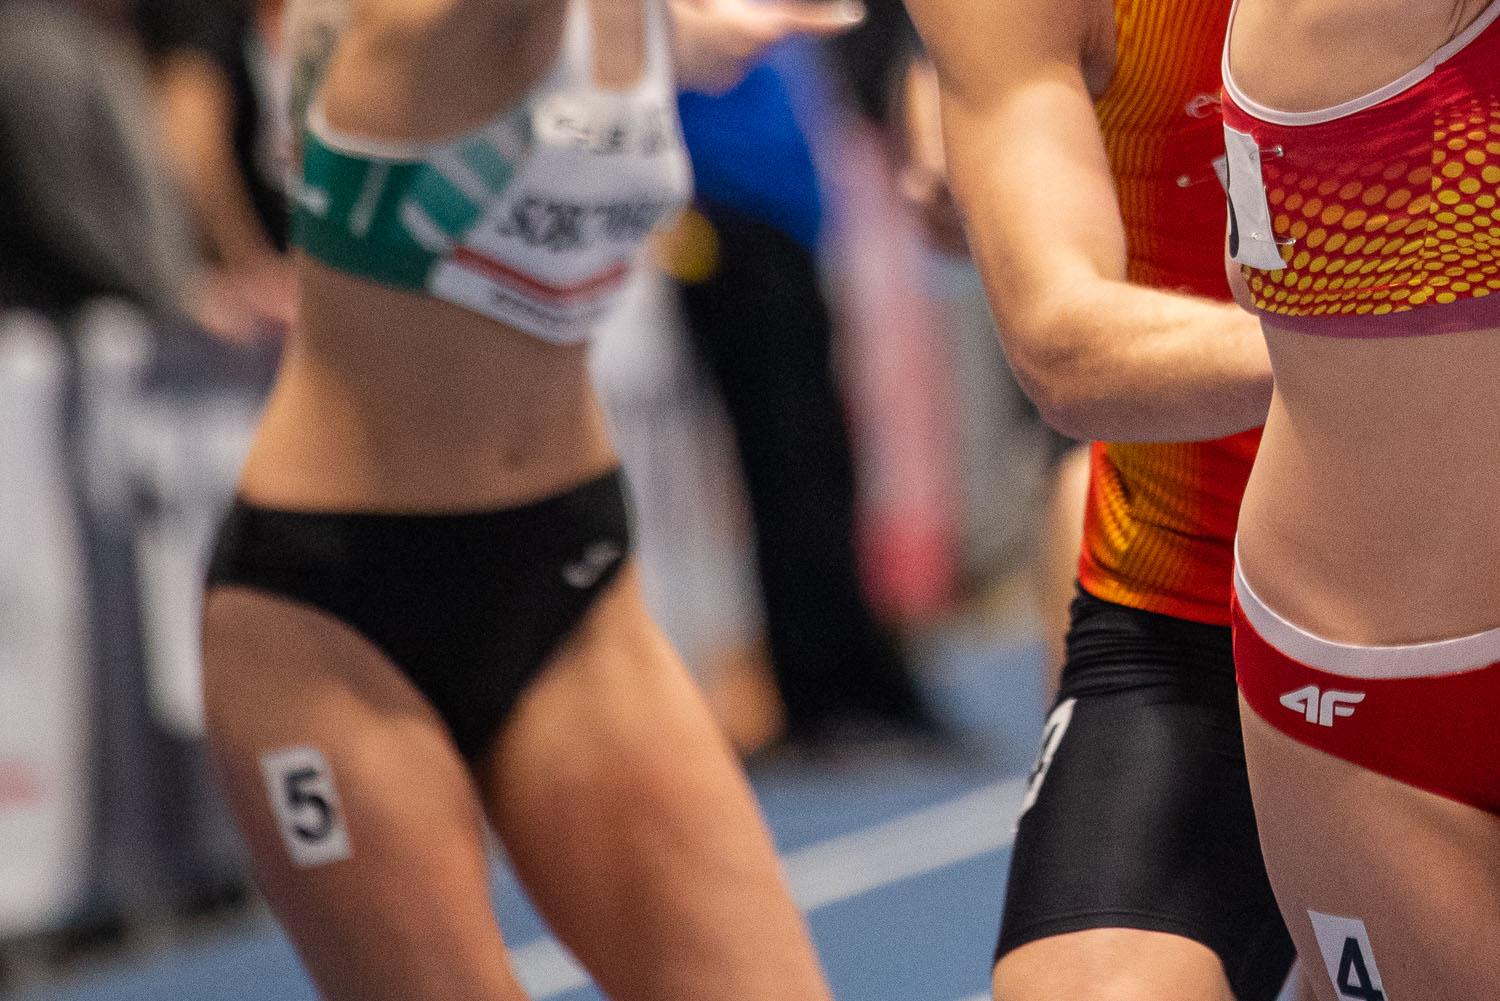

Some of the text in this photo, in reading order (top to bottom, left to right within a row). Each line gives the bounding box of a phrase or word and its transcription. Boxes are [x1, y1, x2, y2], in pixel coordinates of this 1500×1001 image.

[1279, 685, 1366, 728] 4F
[284, 766, 334, 843] 5
[1336, 936, 1386, 1001] 4
